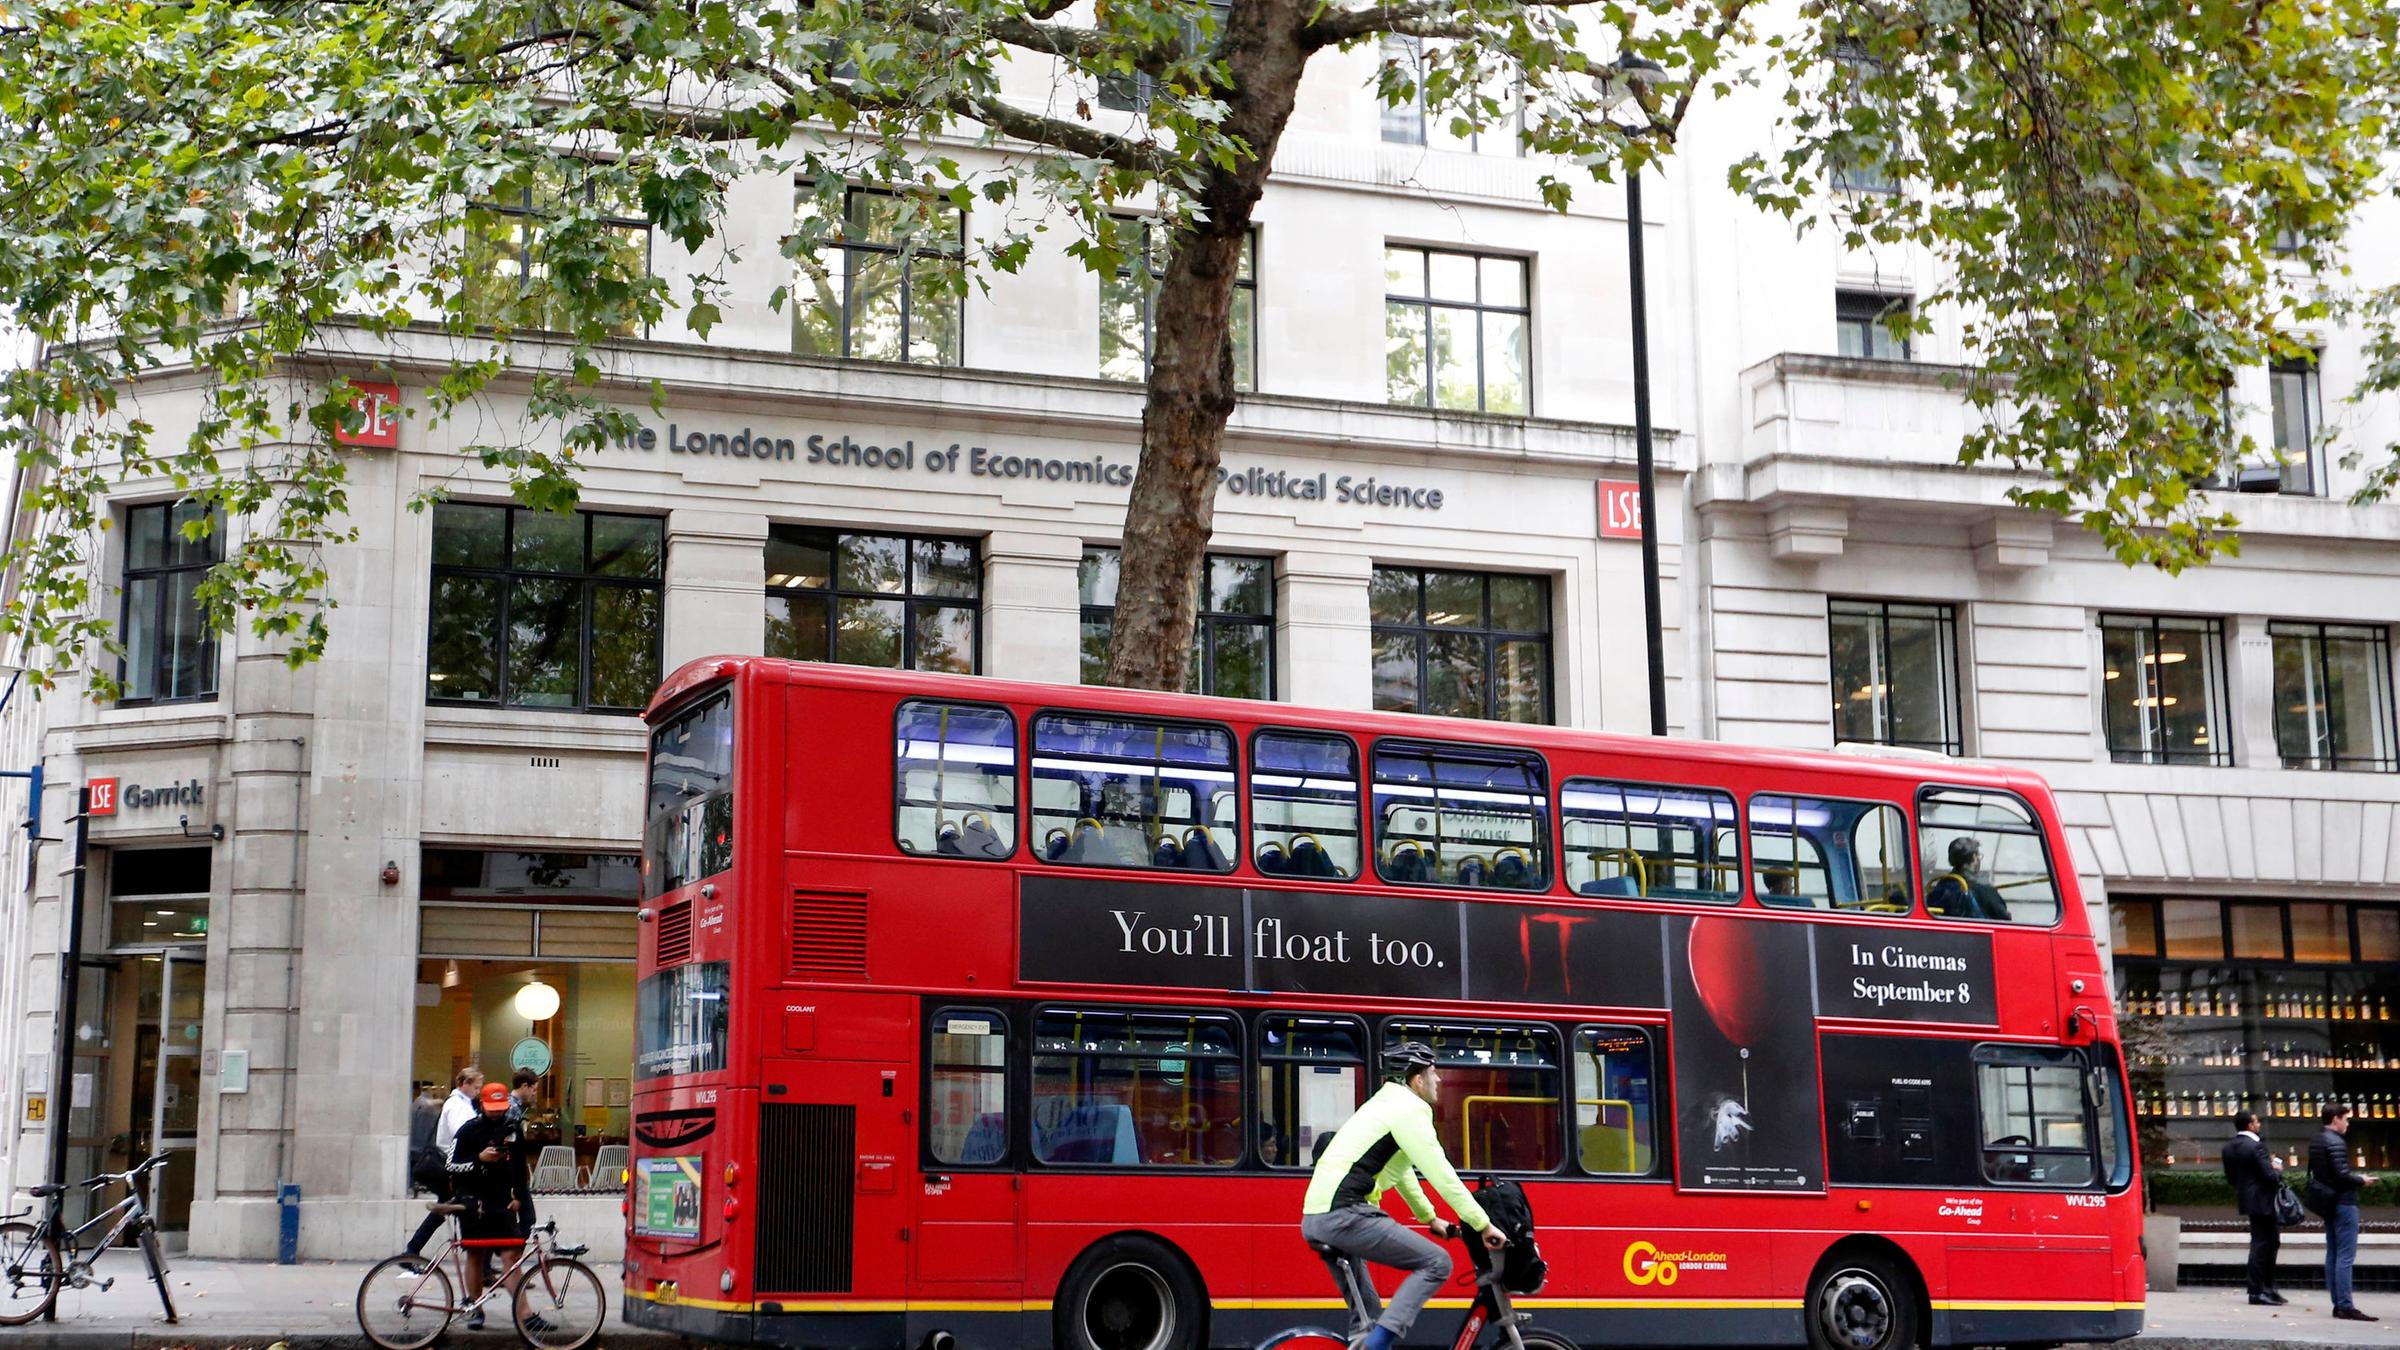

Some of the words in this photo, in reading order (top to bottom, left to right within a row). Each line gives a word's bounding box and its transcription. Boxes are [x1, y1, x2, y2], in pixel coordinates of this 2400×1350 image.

[669, 424, 795, 460] London
[807, 434, 914, 470] School
[925, 443, 960, 472] of
[970, 447, 1134, 487] Economics
[1216, 465, 1327, 500] Political
[1336, 475, 1444, 510] Science
[1608, 489, 1642, 530] LSE
[91, 783, 112, 809] LSE
[123, 779, 204, 809] Garrick
[1109, 909, 1233, 957] You'll
[1253, 917, 1351, 963] float
[1367, 932, 1445, 968] too.
[1519, 911, 1598, 997] IT
[1851, 944, 1875, 966] In
[1881, 945, 1967, 972] Cinemas
[1853, 976, 1955, 1007] September
[1958, 982, 1970, 1004] 8
[1938, 1205, 1983, 1216] Go-Ahead
[2065, 1194, 2107, 1207] WVL295
[1623, 1241, 1678, 1286] Go
[1653, 1250, 1727, 1262] Ahead-London
[1679, 1262, 1703, 1270] LONDON
[1703, 1262, 1728, 1271] CENTRAL
